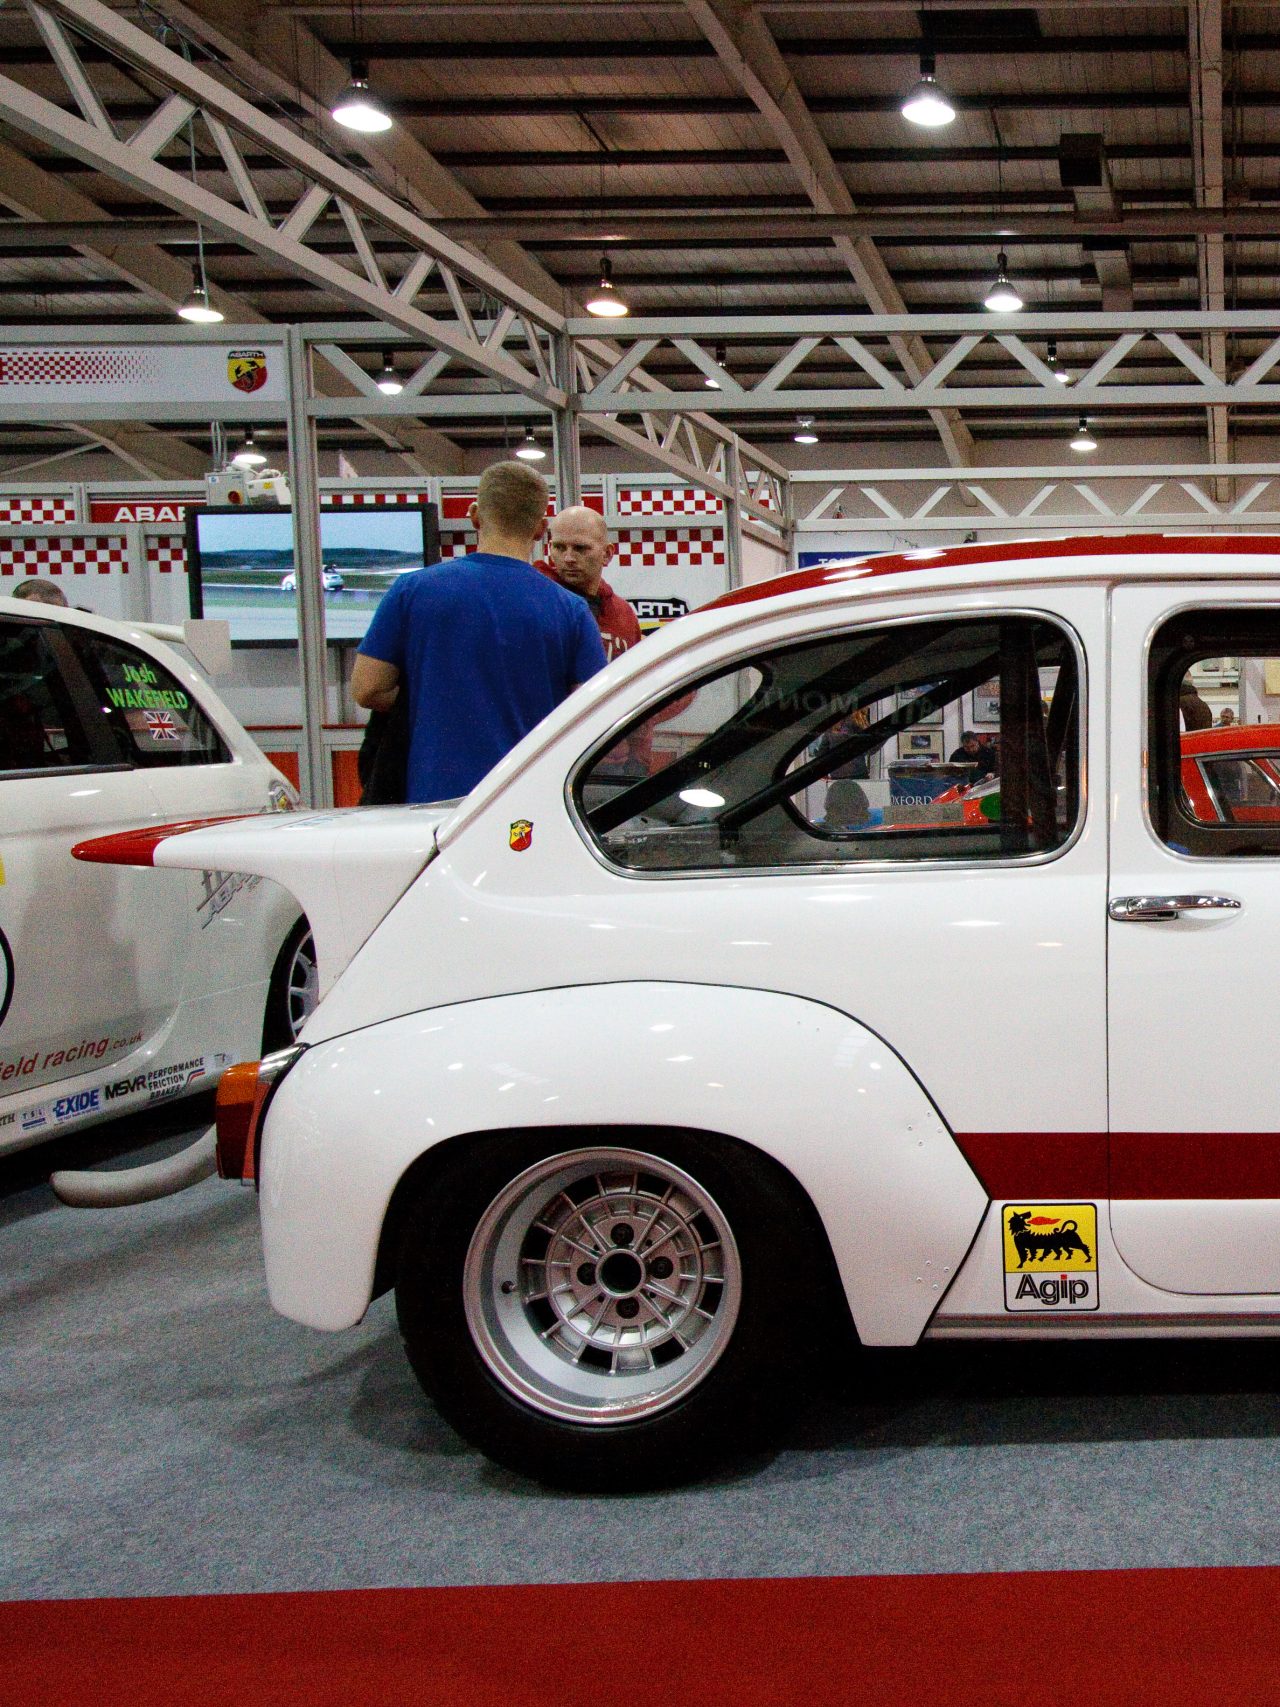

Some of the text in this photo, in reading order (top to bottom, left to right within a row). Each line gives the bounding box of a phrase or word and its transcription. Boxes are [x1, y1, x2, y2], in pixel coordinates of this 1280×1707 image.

[122, 663, 157, 684] Josh
[105, 687, 189, 710] WAKEFIELD
[147, 1057, 205, 1080] PERFORMANCE
[104, 1074, 148, 1100] MSVR
[148, 1073, 184, 1091] FRICTION
[54, 1089, 100, 1118] EXIDE
[1015, 1273, 1090, 1306] Agip
